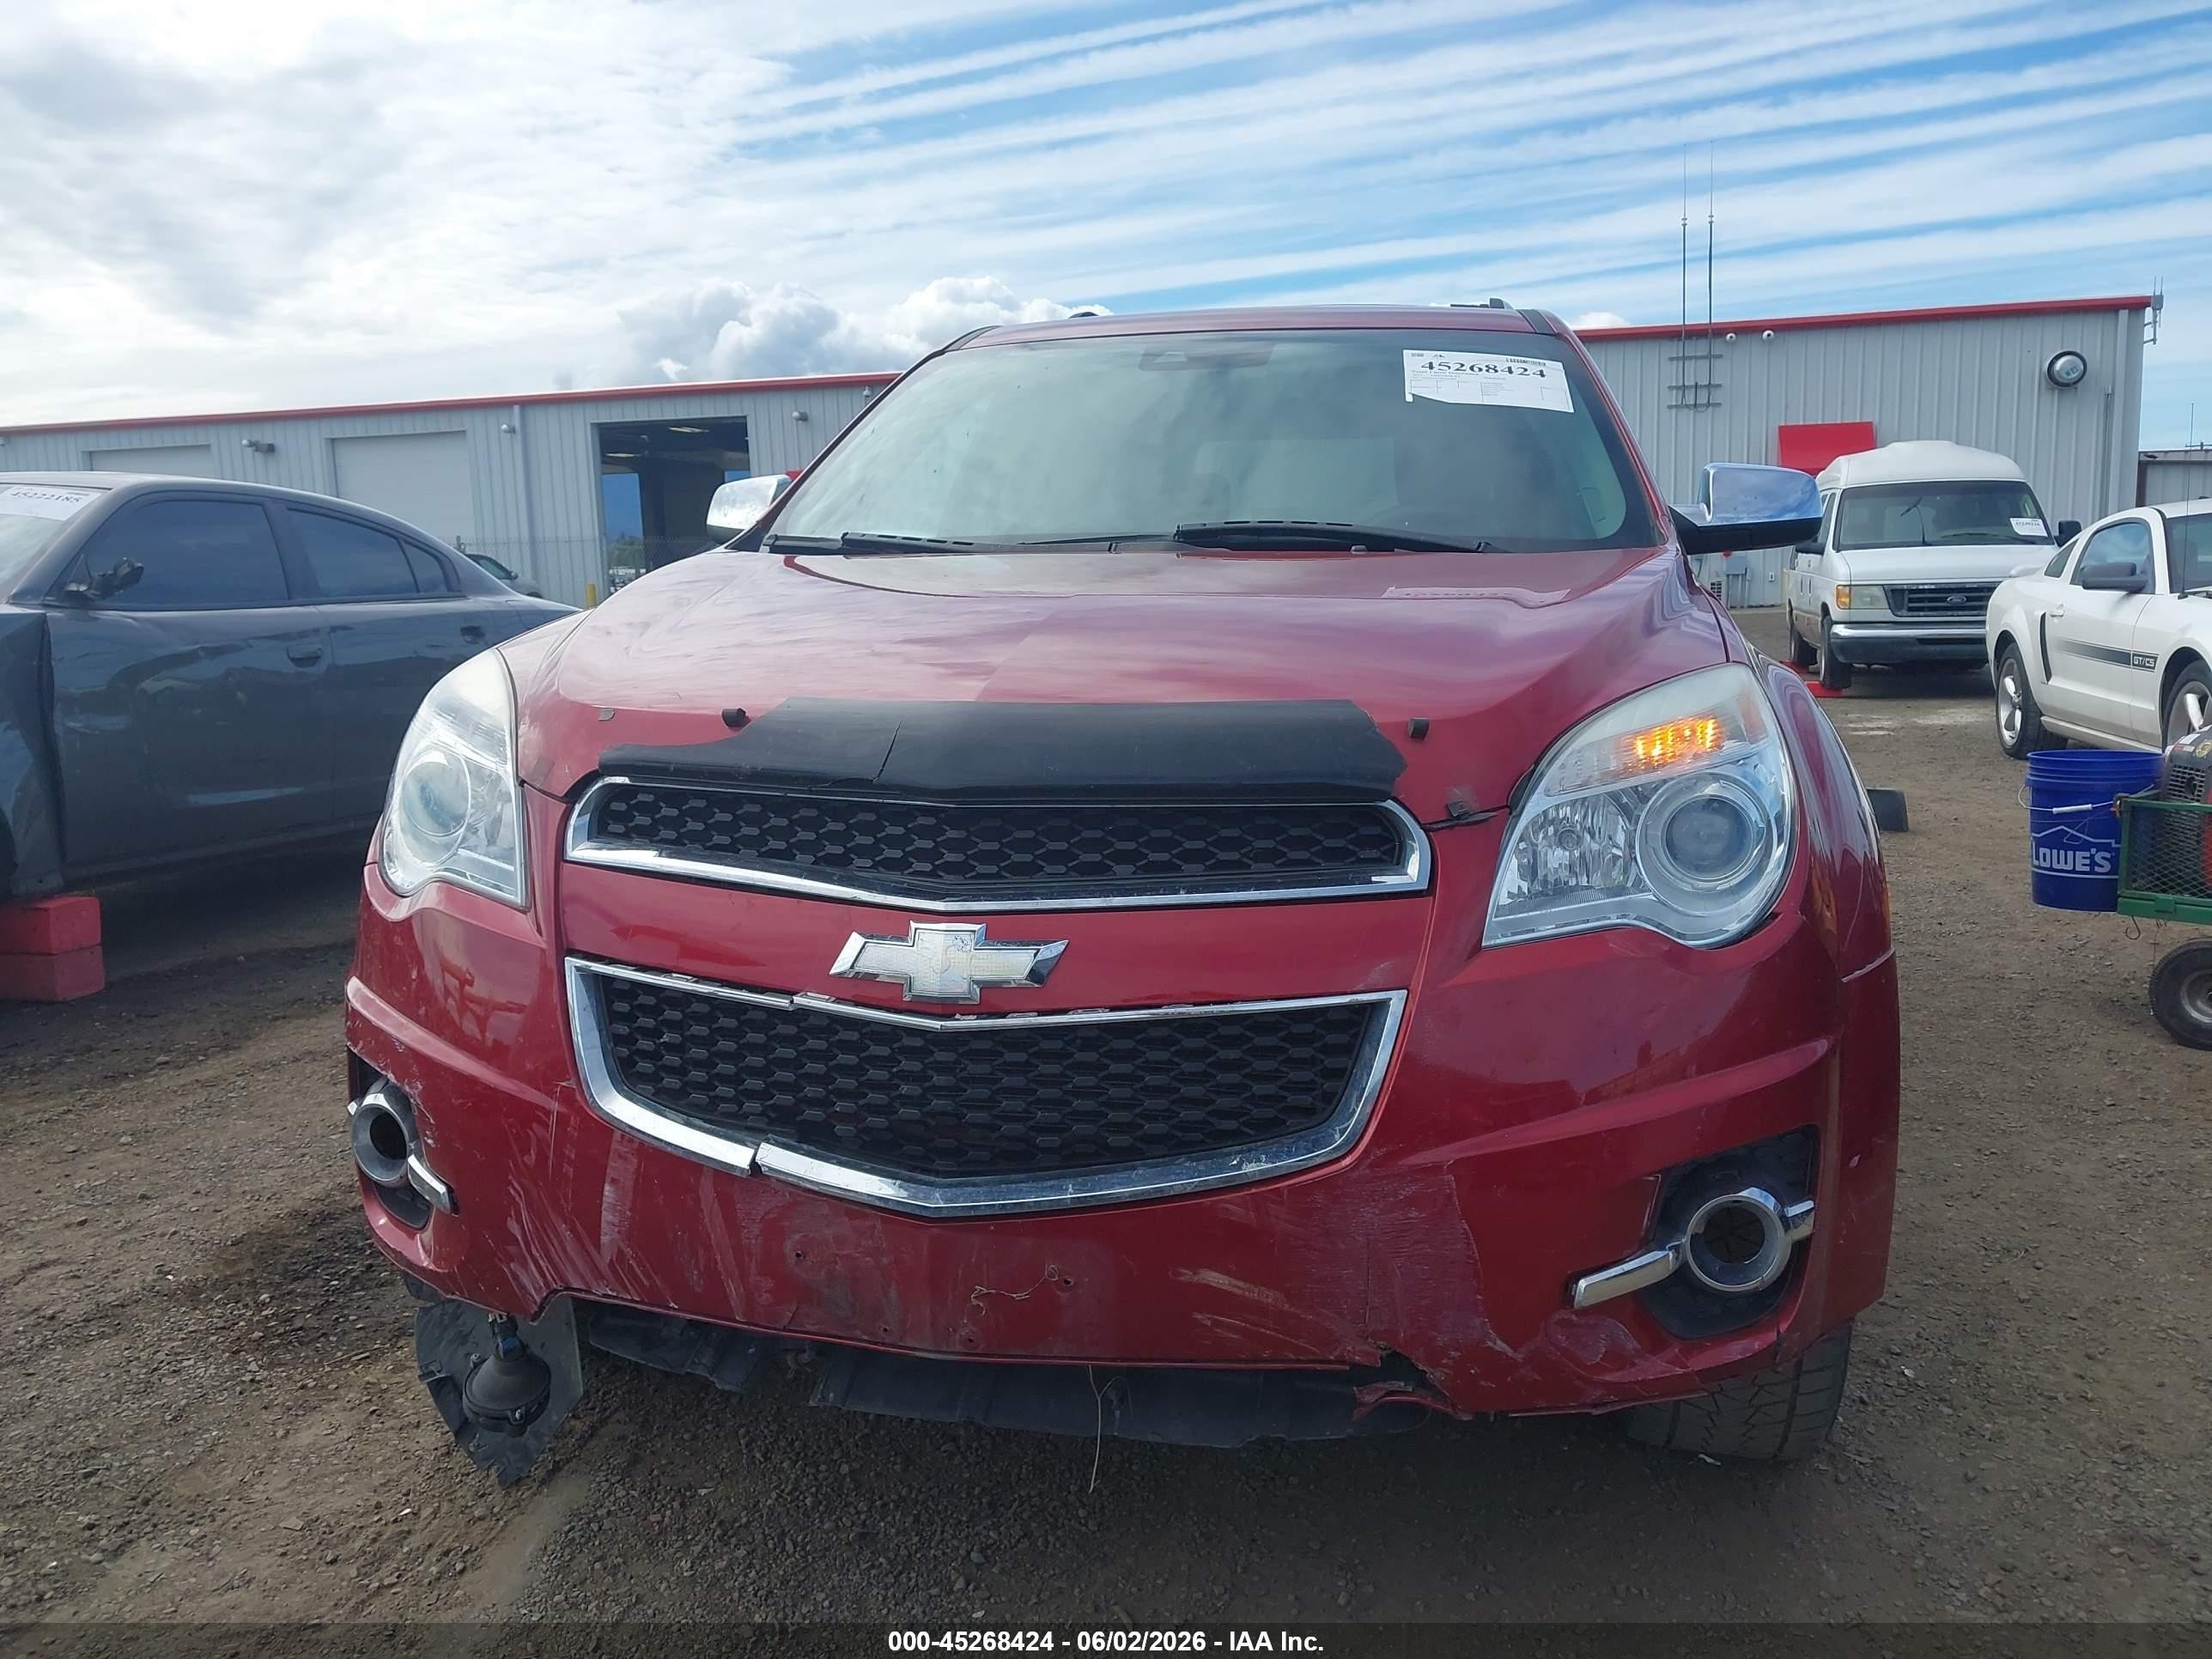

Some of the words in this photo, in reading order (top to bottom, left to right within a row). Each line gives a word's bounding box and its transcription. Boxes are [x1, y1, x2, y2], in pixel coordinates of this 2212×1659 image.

[1421, 362, 1547, 378] 45268424
[2133, 656, 2155, 667] GT/CS
[2033, 839, 2112, 873] LOWE'S
